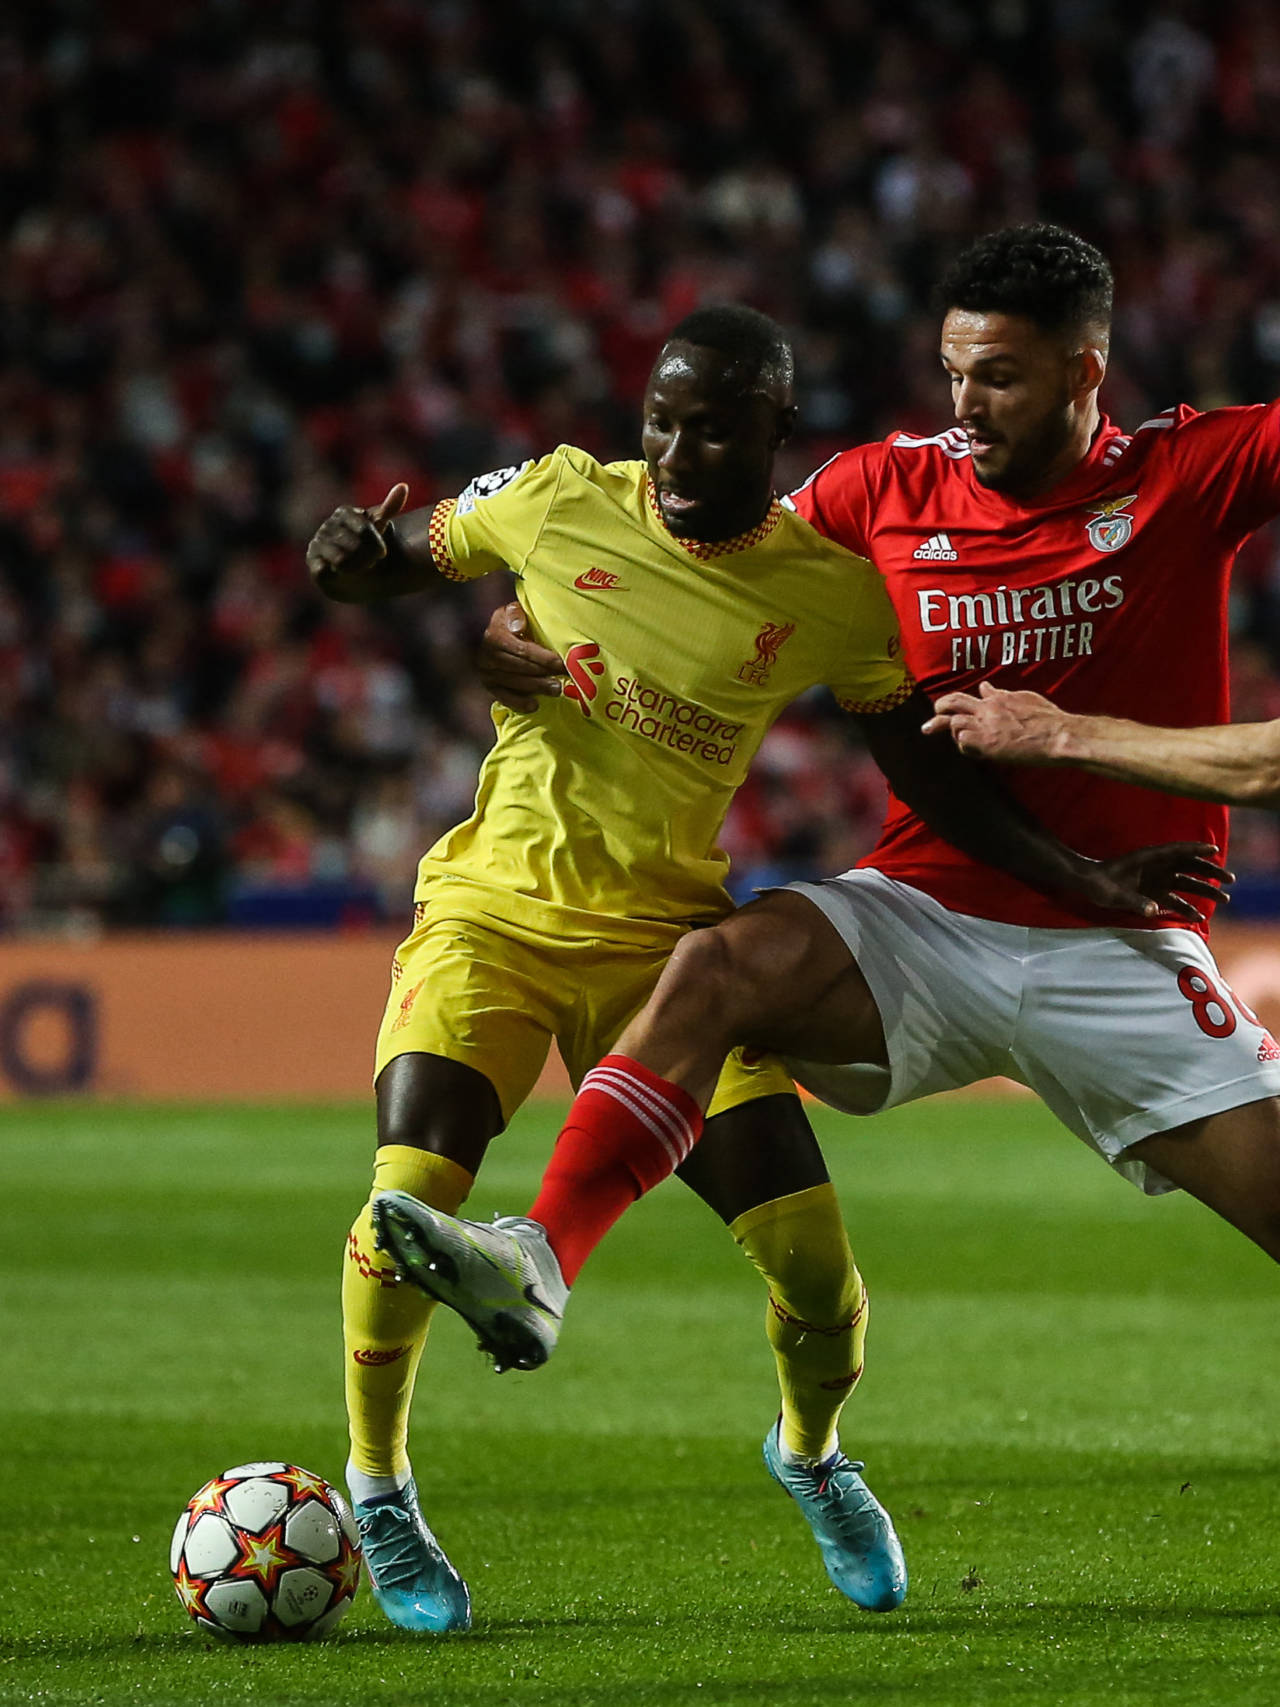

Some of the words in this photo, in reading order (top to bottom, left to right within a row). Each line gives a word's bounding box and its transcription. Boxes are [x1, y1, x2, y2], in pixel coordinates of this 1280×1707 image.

[583, 567, 619, 585] NIKE
[913, 548, 958, 561] adidas
[917, 575, 1125, 633] Emirates
[951, 634, 991, 672] FLY
[1001, 621, 1093, 666] BETTER
[605, 700, 736, 766] chartered
[613, 676, 745, 741] standard
